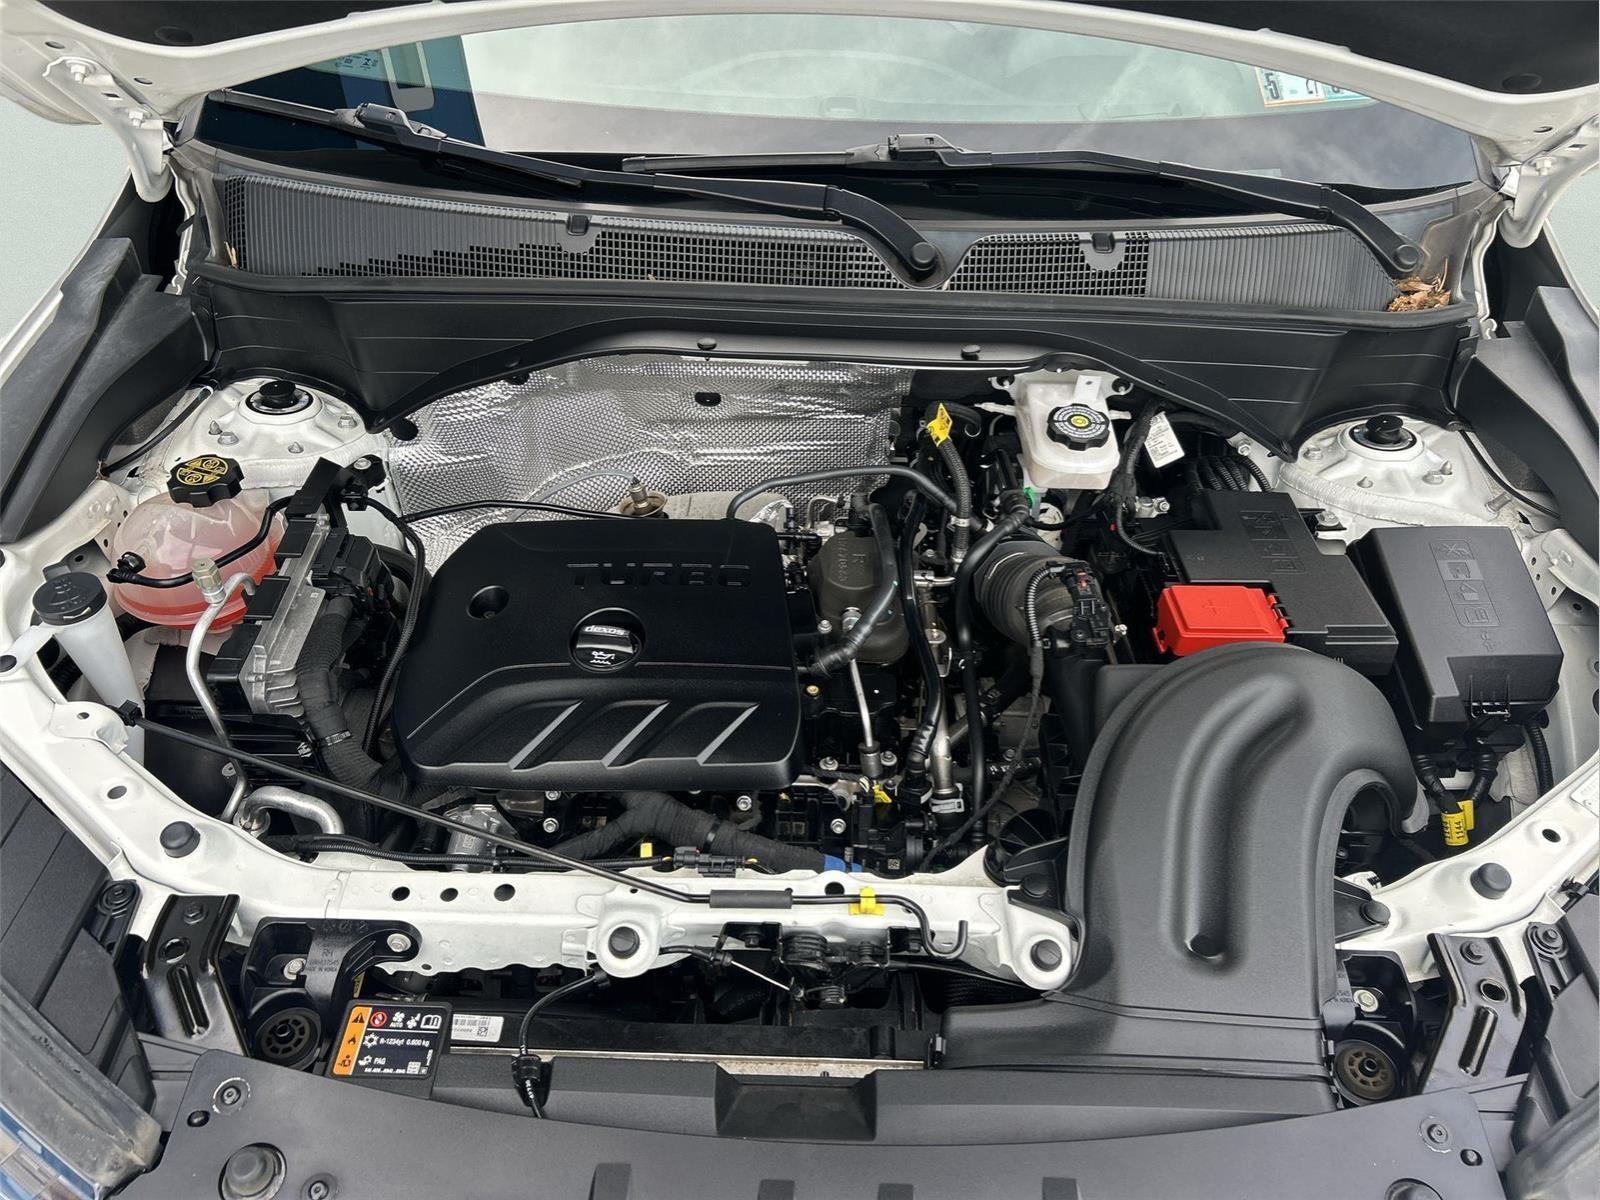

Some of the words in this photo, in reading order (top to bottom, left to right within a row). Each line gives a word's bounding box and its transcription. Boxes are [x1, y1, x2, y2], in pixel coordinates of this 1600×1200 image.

[567, 563, 750, 586] TURBO
[584, 625, 626, 636] dexos
[379, 1038, 404, 1046] R-1234yf
